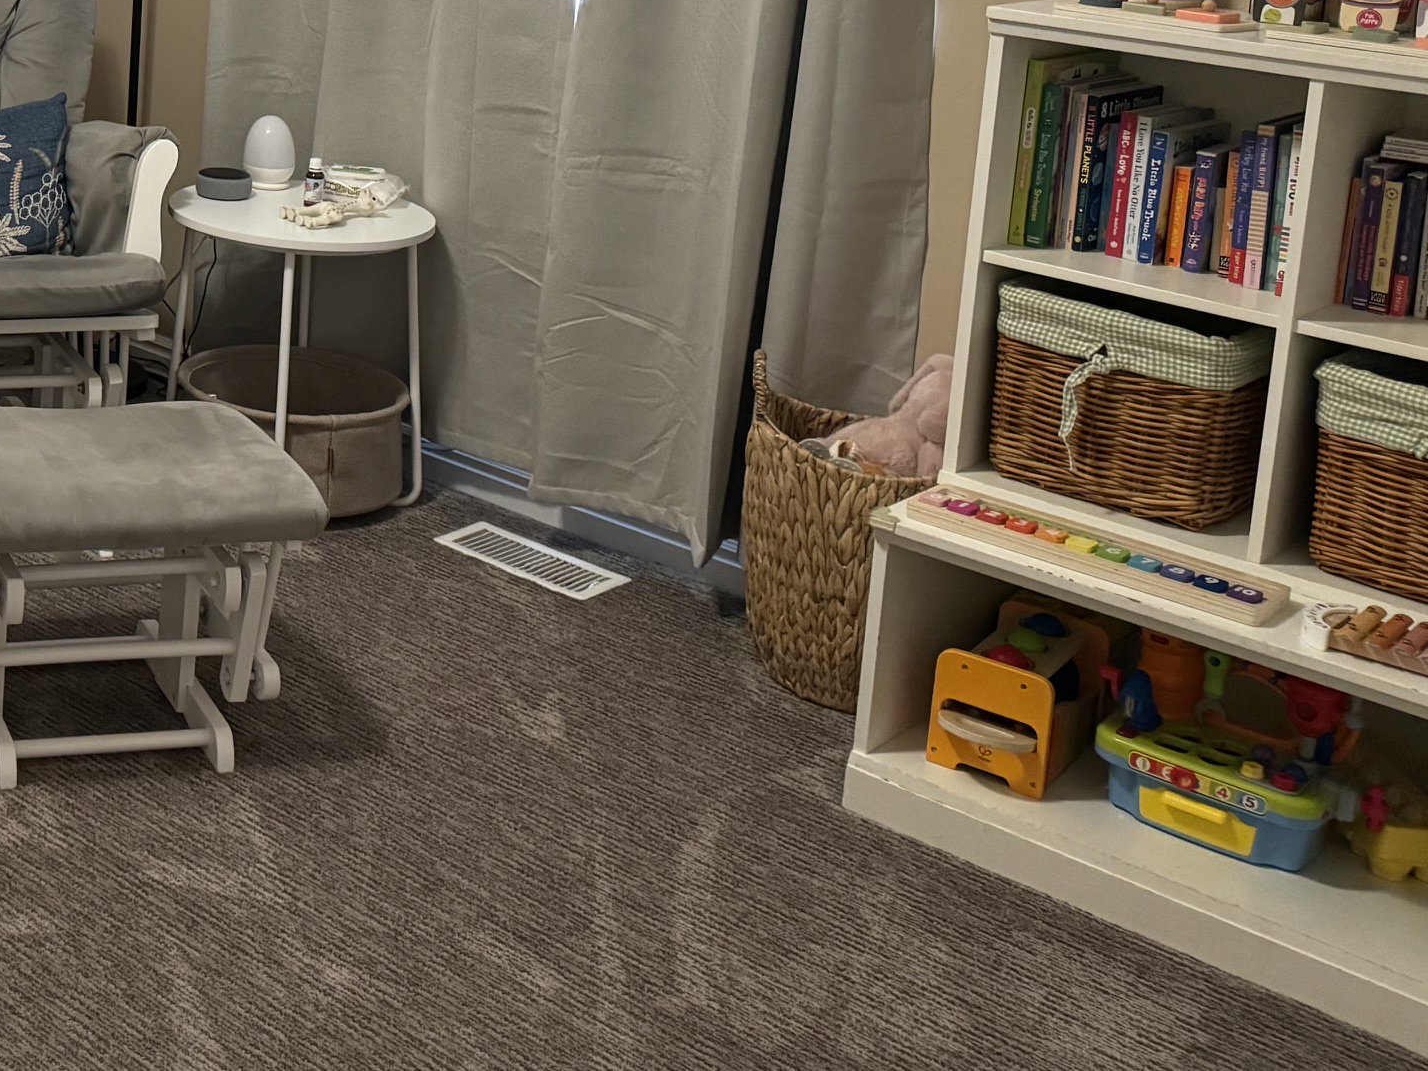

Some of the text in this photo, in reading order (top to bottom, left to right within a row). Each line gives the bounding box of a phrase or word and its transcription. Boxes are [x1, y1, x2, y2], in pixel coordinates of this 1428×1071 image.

[1101, 101, 1108, 118] 8
[1084, 114, 1095, 143] LITTLE
[1137, 128, 1147, 147] Love
[1080, 145, 1092, 184] PLANETS
[1117, 154, 1130, 176] Love
[1135, 148, 1145, 164] You
[1133, 165, 1143, 183] Like
[1150, 158, 1161, 186] Little
[1131, 184, 1140, 196] No
[1147, 189, 1157, 209] Blue
[1129, 197, 1139, 219] Otter
[1141, 210, 1155, 241] Truck
[1105, 547, 1121, 555] 6
[1169, 566, 1185, 575] 8
[1204, 576, 1220, 585] 9
[1233, 586, 1257, 596] 10
[1217, 787, 1228, 799] 4
[1244, 796, 1255, 808] 5
